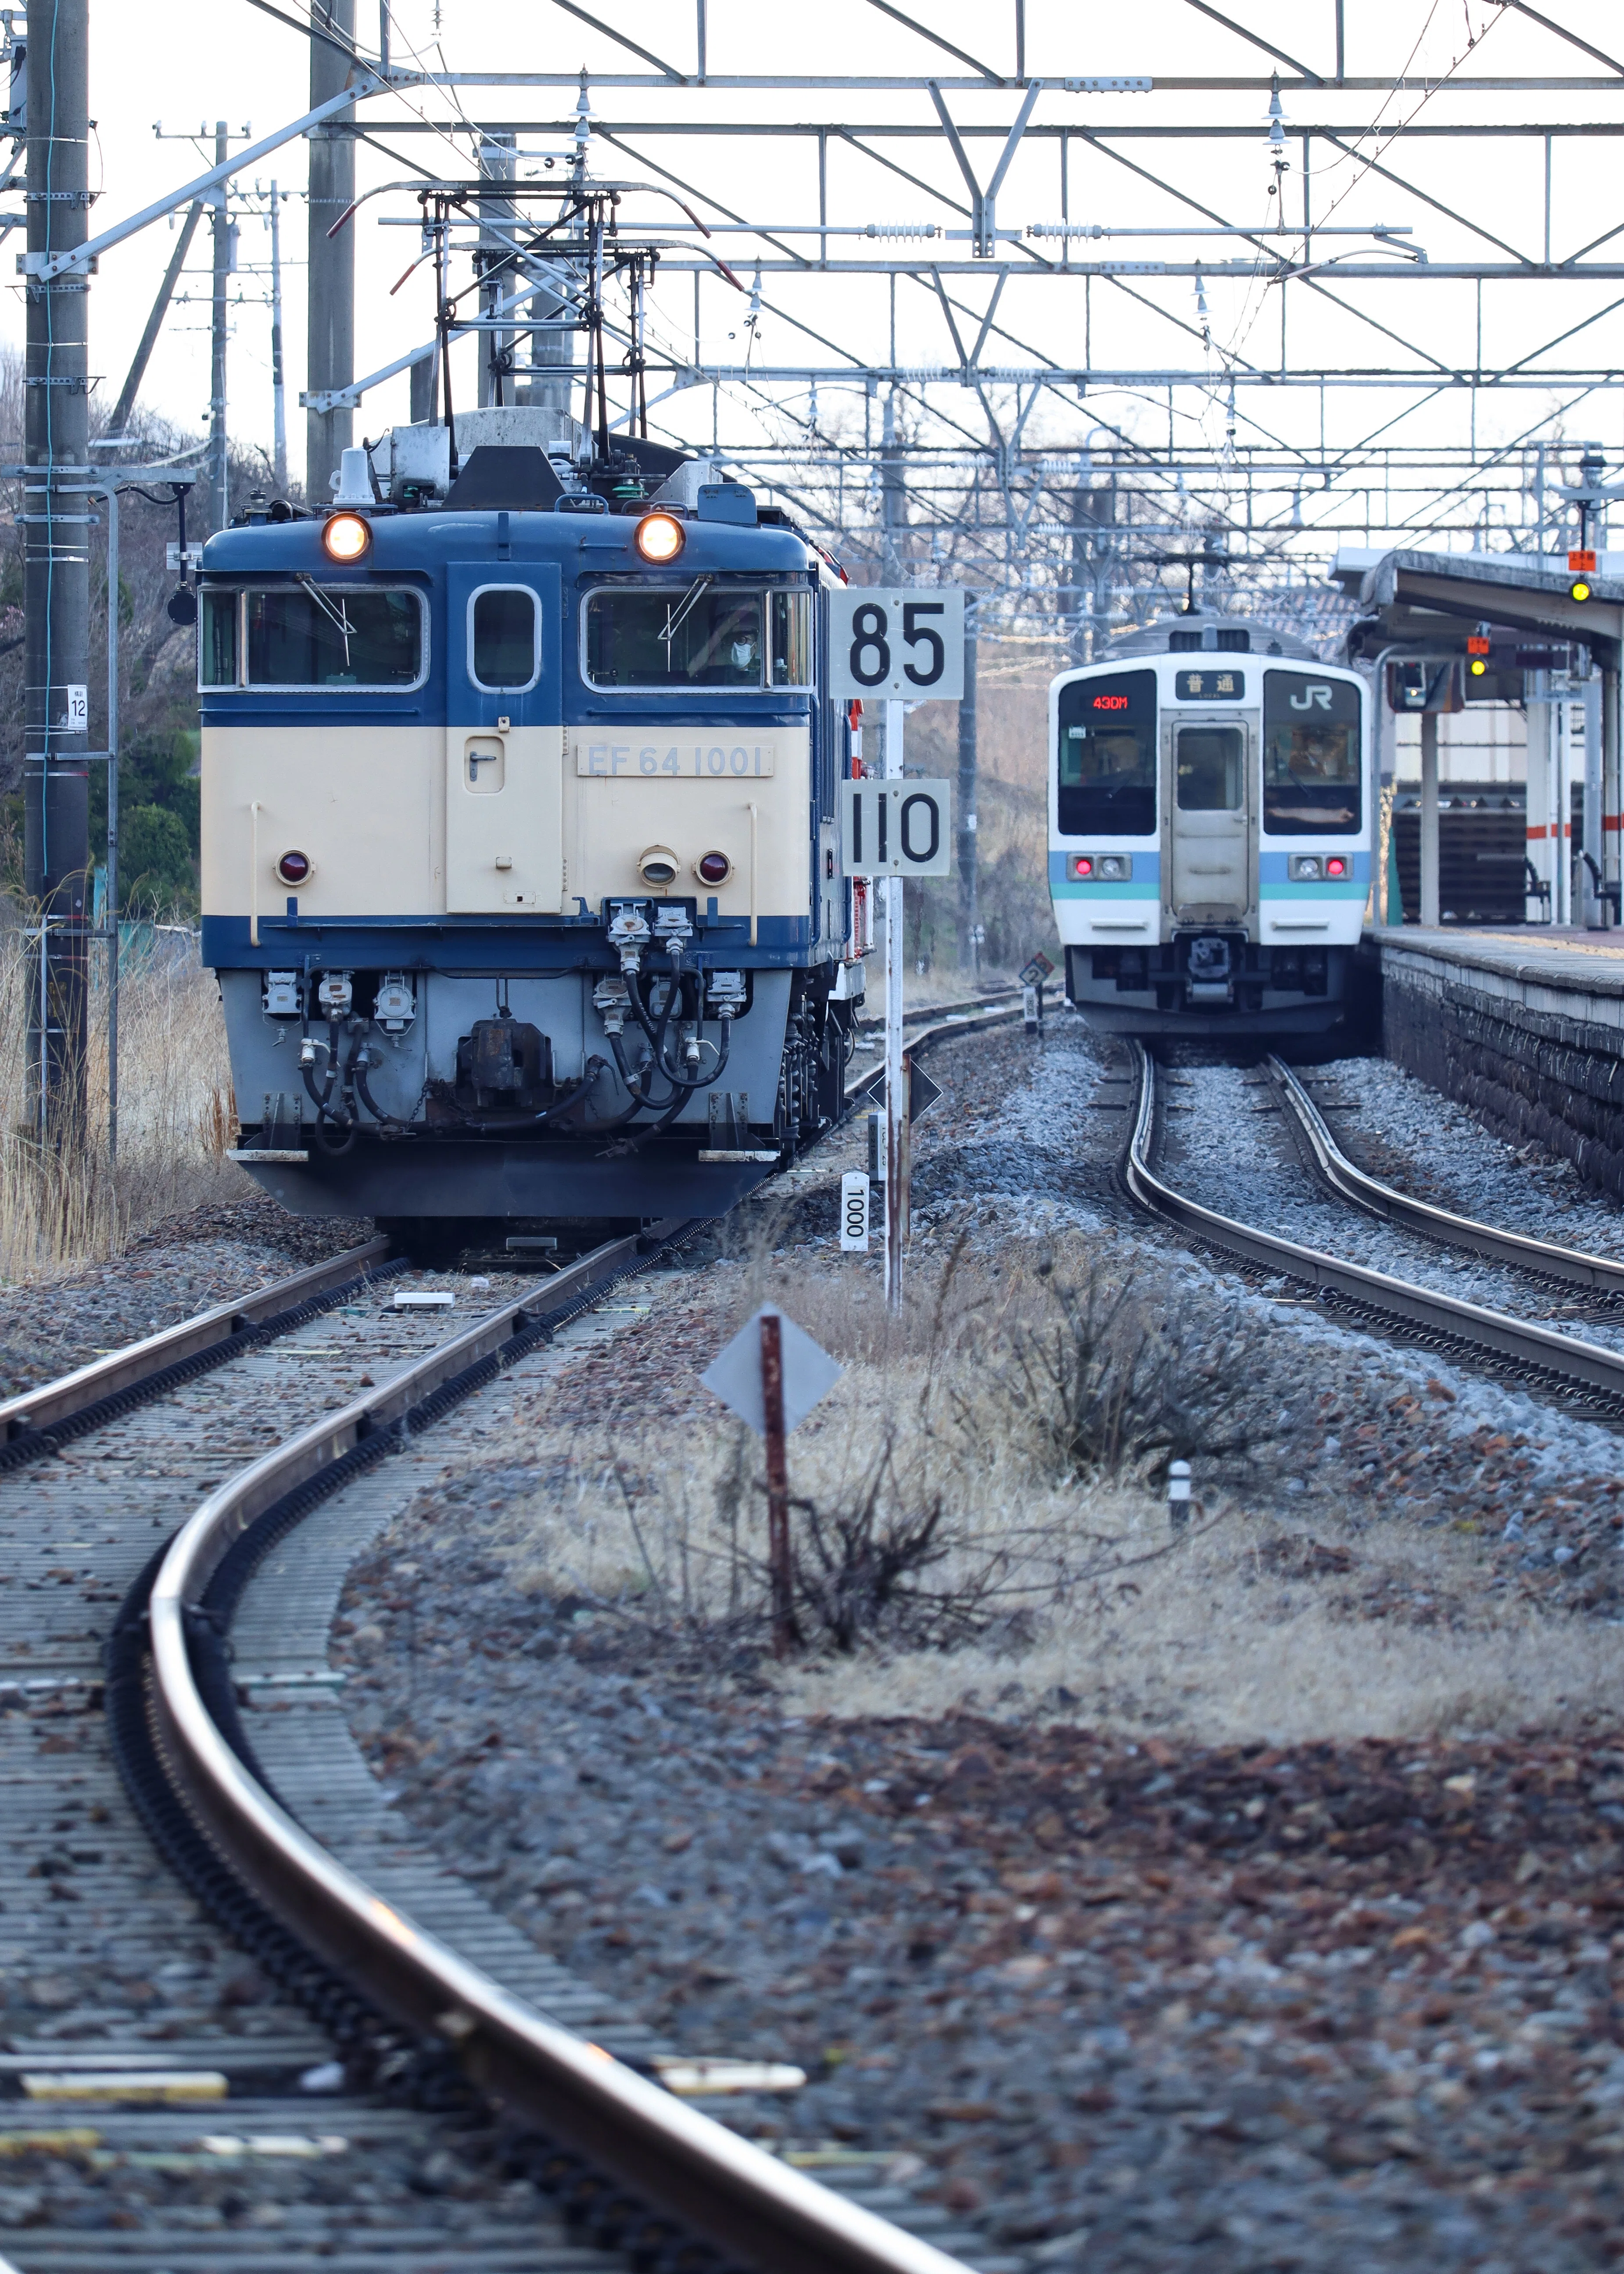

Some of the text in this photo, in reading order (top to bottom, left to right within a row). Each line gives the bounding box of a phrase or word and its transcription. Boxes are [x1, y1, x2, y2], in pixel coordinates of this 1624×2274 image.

[850, 603, 944, 686] 85
[1187, 673, 1234, 692] 普通
[72, 700, 85, 716] 12
[1093, 696, 1128, 710] 430M
[1290, 685, 1332, 710] JR
[589, 746, 761, 775] EF 64 1001
[853, 793, 939, 862] 110
[847, 1189, 864, 1237] 1000
